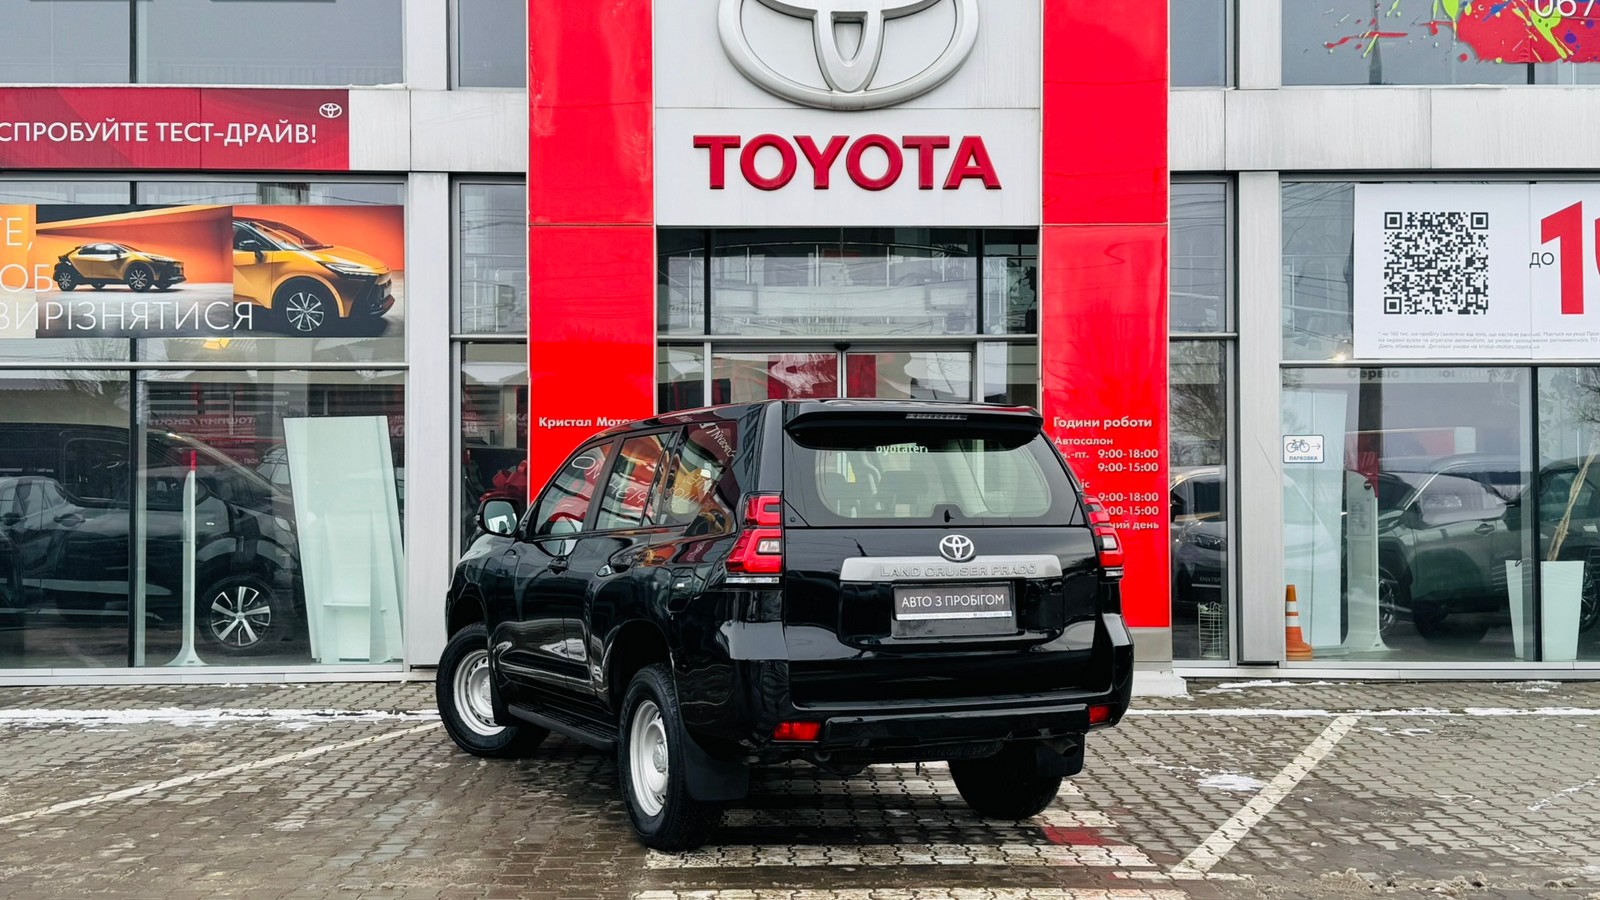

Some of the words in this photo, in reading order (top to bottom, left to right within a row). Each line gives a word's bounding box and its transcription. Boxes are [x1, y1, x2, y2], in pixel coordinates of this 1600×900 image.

[0, 118, 148, 143] СПРОБУЙТЕ
[155, 119, 317, 147] ТЕСТ-ДРАЙВ!
[693, 133, 1003, 191] TOYOTA
[0, 217, 33, 251] Е,
[1541, 201, 1600, 315] 1
[539, 417, 592, 429] Кристал
[1053, 417, 1100, 428] Години
[1104, 416, 1152, 430] роботи
[1054, 436, 1113, 446] Автосалон
[1132, 521, 1159, 530] день
[880, 565, 921, 578] LAND
[924, 564, 989, 577] CRUISER
[991, 562, 1038, 576] PRADO
[901, 595, 933, 608] АВТО
[946, 593, 1006, 607] ПРОБІГОМ
